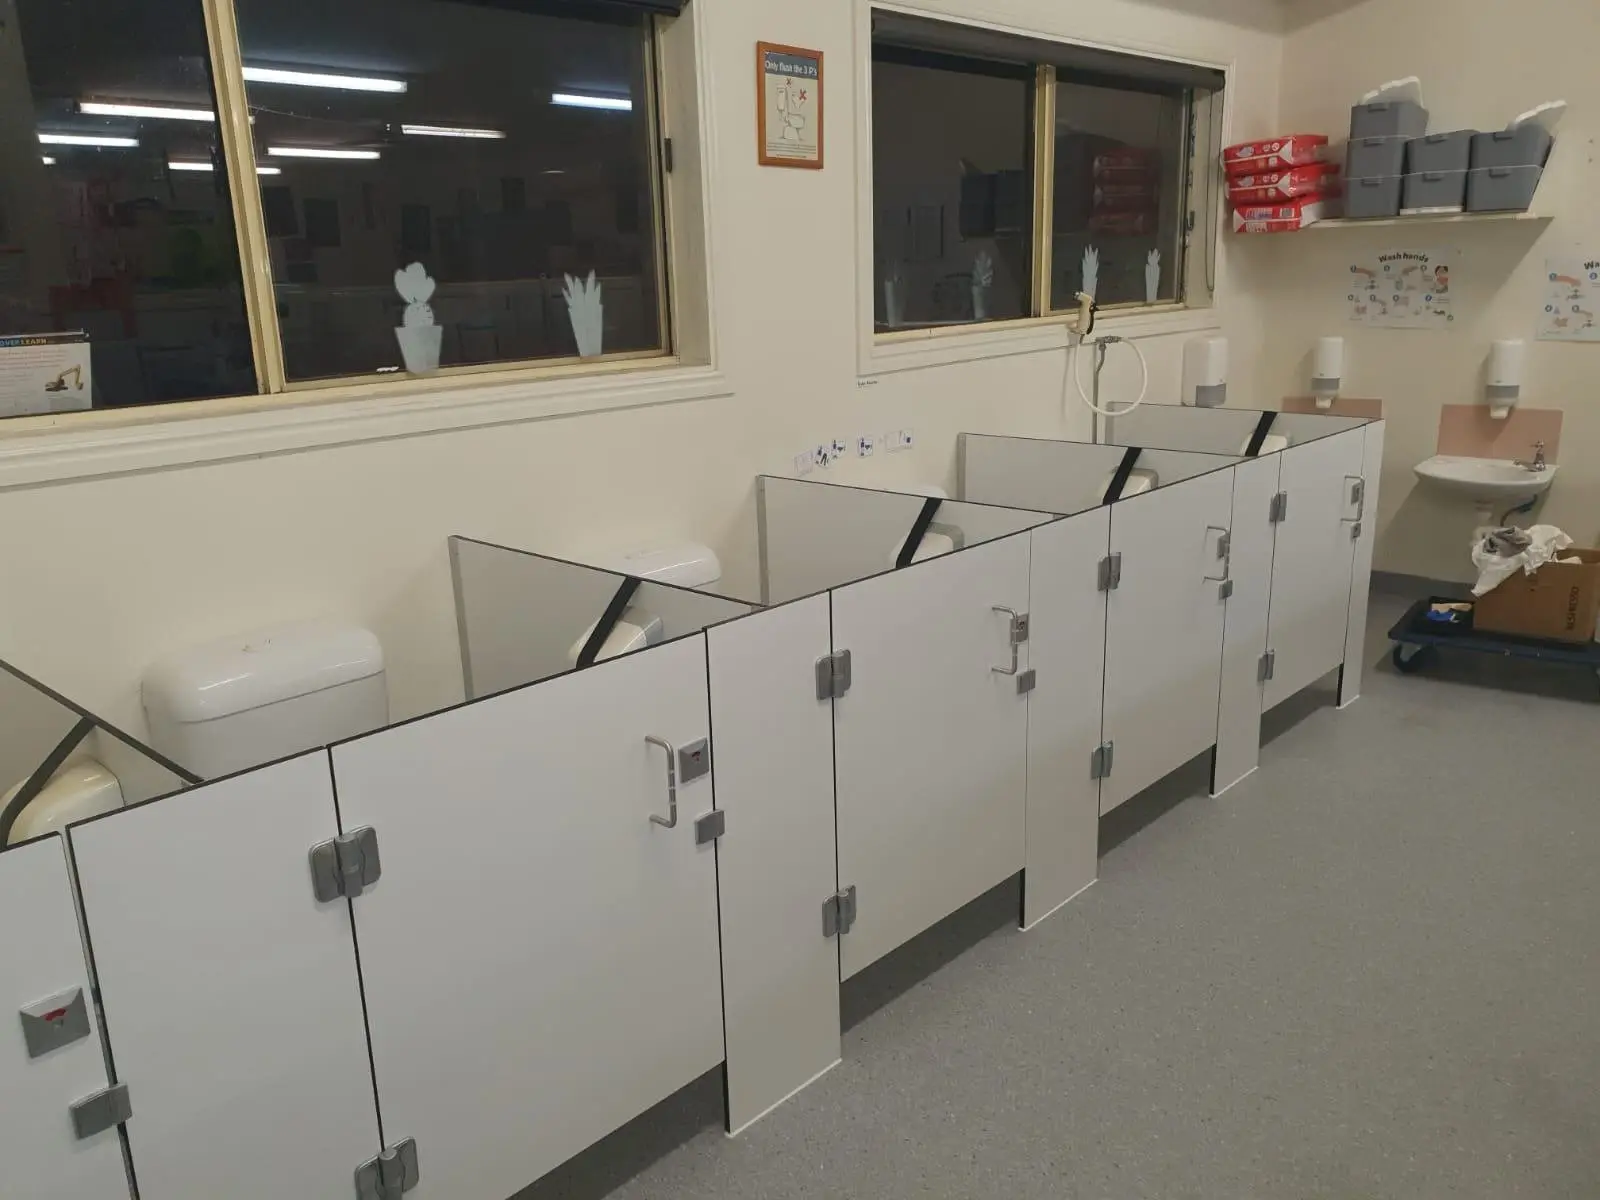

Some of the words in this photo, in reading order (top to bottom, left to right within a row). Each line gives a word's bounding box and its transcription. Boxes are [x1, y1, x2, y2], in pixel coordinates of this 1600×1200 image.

[765, 60, 779, 72] Only
[779, 61, 793, 72] flush
[793, 63, 803, 74] the
[1378, 252, 1401, 263] Wash
[1403, 252, 1429, 263] hands
[20, 338, 47, 346] LEARN
